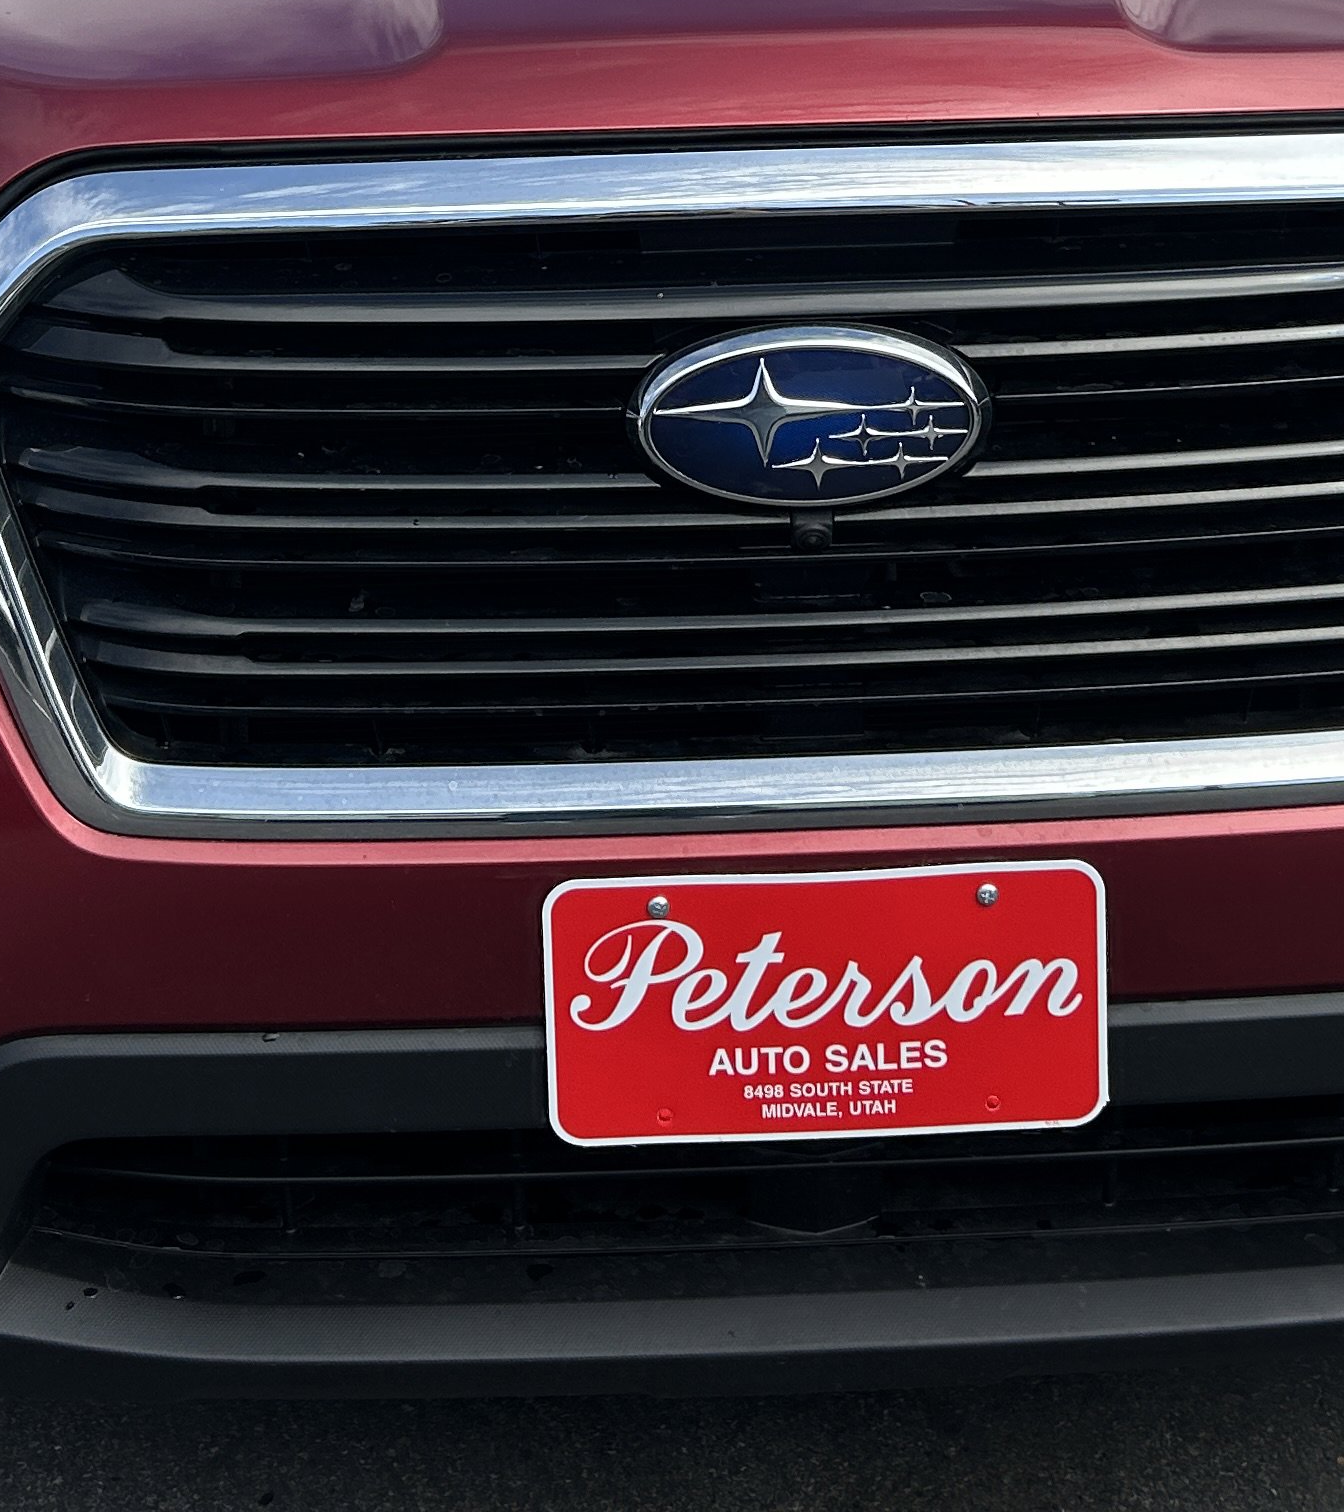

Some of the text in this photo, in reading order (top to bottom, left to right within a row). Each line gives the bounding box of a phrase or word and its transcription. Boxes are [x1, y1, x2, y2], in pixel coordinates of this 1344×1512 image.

[570, 919, 1083, 1031] Peterson
[709, 1039, 948, 1076] AUTO SALES
[743, 1079, 914, 1100] 8498 SOUTH STATE
[761, 1099, 897, 1120] MIDVALE, UTAH
